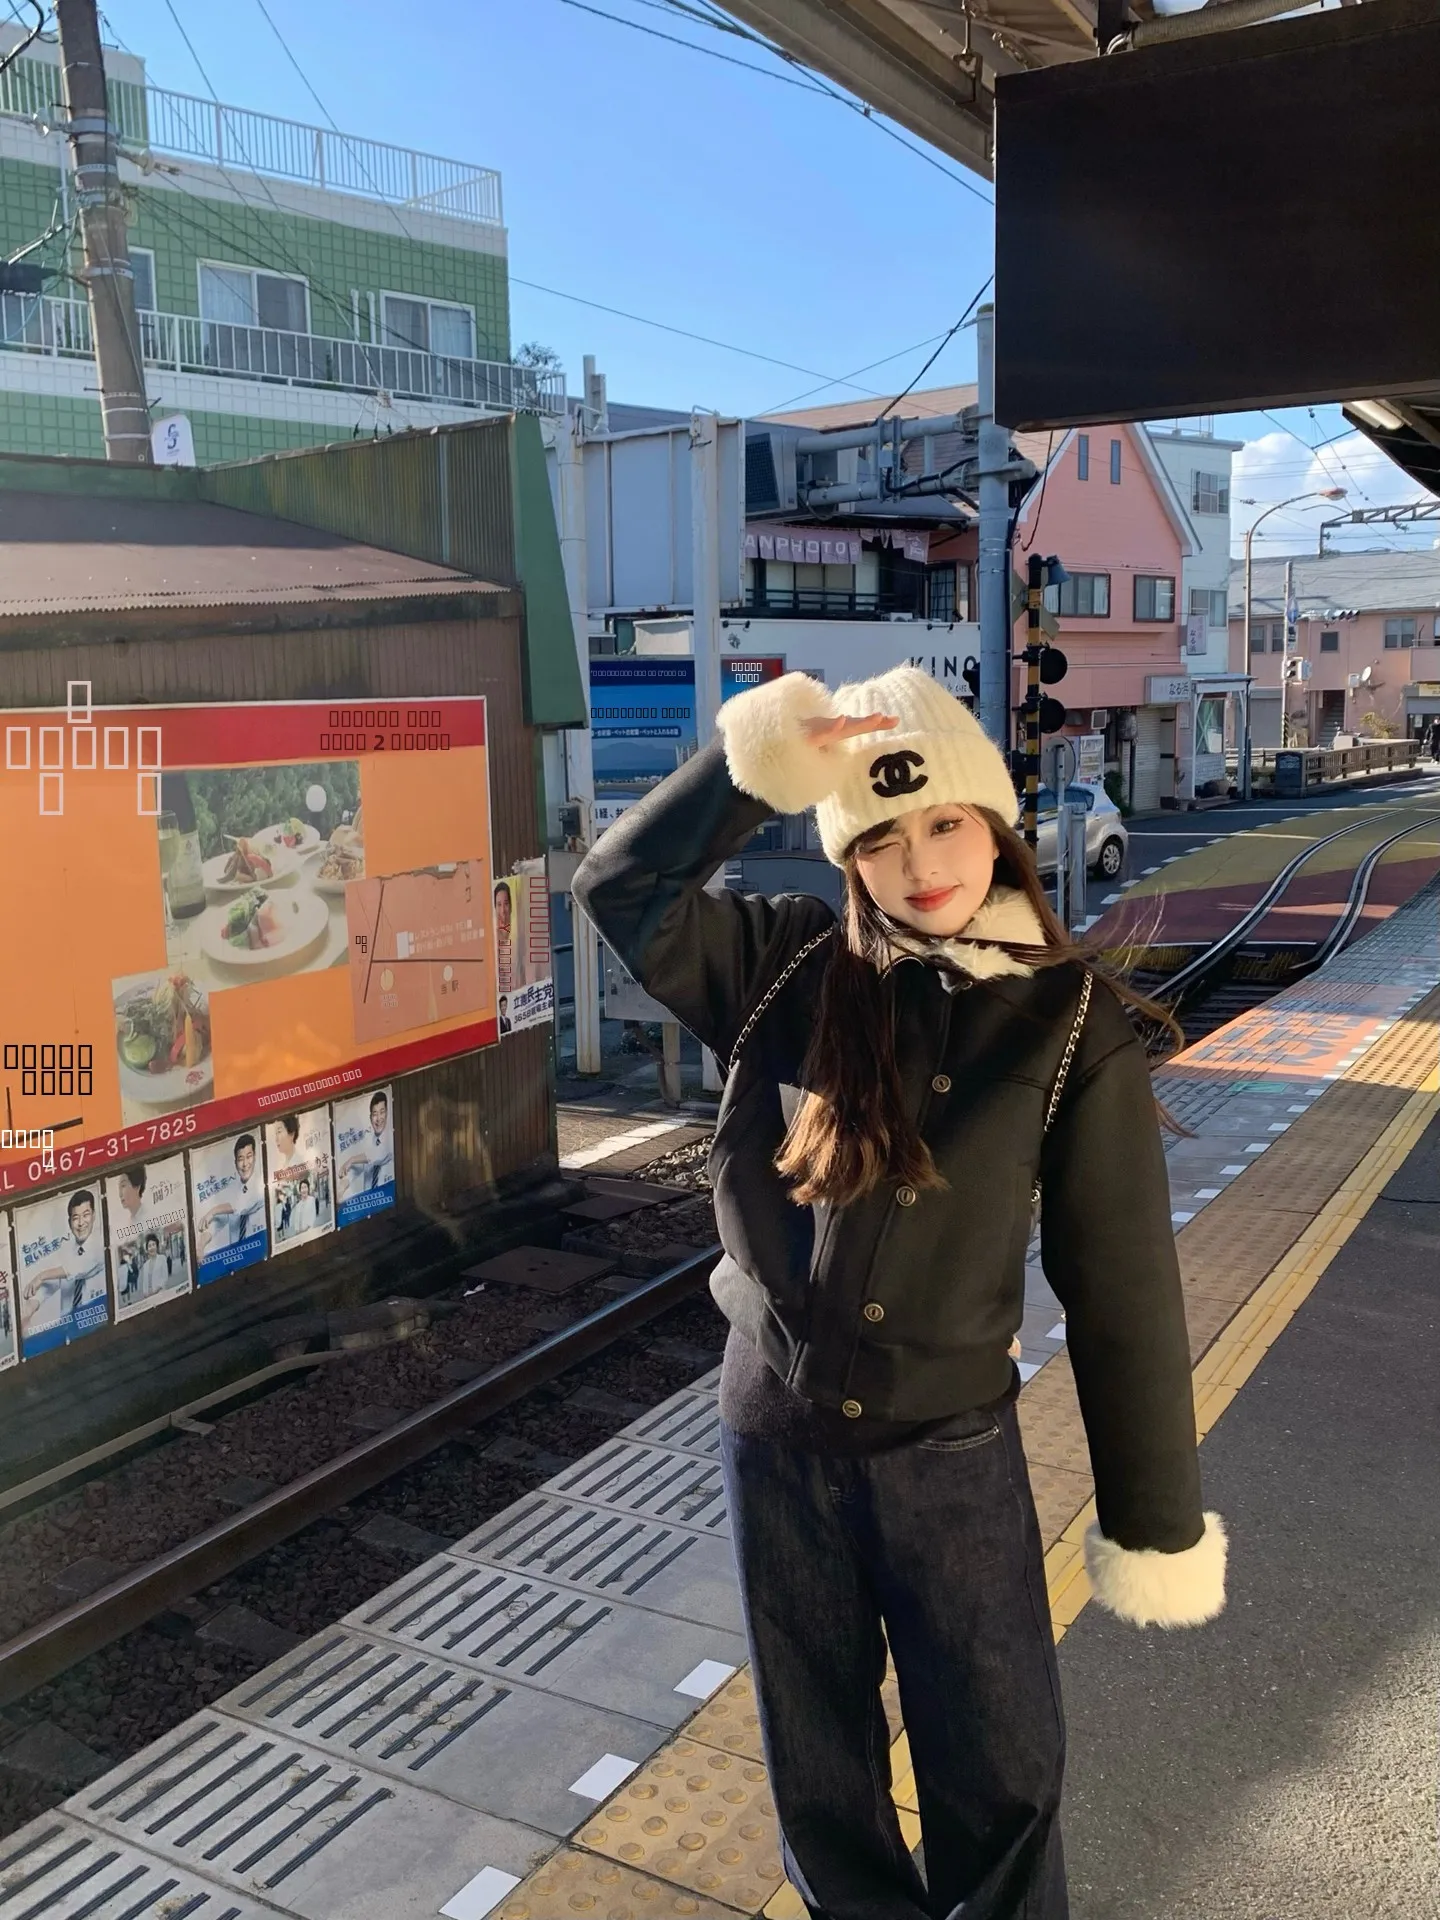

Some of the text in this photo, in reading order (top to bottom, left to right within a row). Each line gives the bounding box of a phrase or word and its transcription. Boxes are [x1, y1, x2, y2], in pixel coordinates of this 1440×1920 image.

[1169, 682, 1189, 696] なる浜
[338, 1128, 355, 1142] もっと
[196, 1175, 217, 1191] もっと
[22, 1236, 47, 1254] もっと
